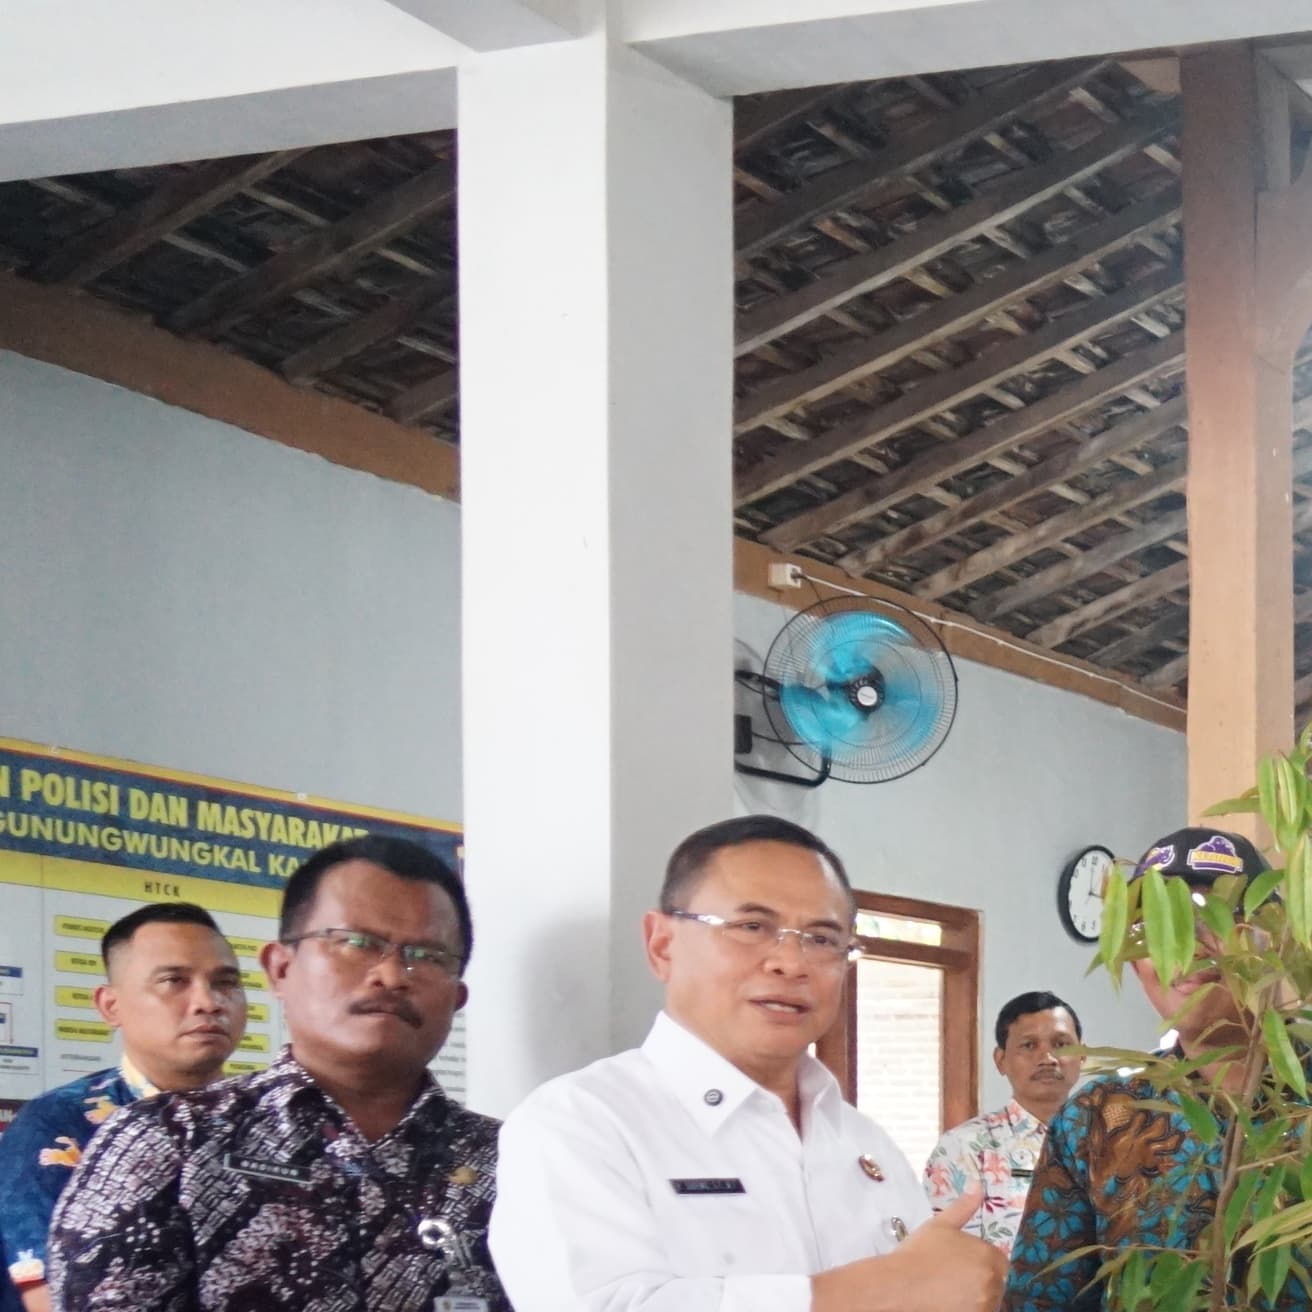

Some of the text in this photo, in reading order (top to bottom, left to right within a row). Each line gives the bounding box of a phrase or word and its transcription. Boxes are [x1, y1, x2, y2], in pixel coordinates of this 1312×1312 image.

[20, 769, 119, 816] POLISI
[128, 787, 189, 828] DAN
[197, 801, 369, 849] MASYARAK
[269, 854, 308, 877] KA
